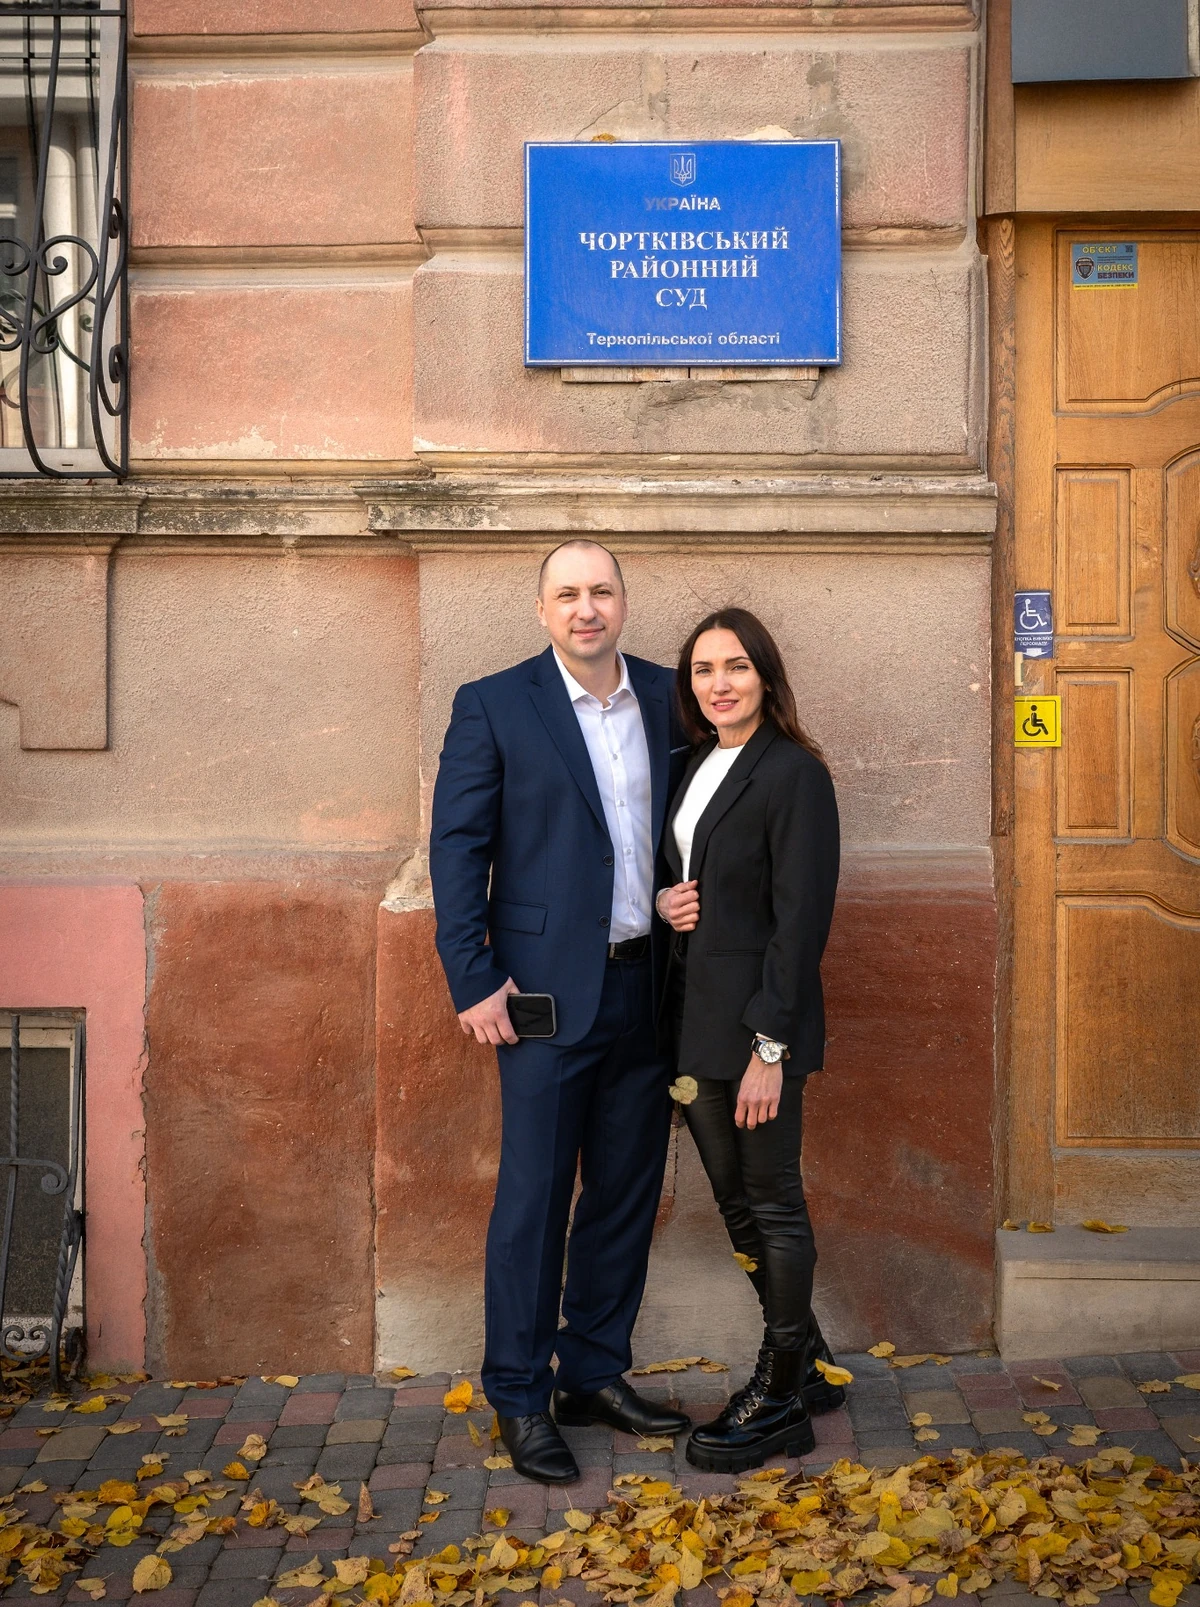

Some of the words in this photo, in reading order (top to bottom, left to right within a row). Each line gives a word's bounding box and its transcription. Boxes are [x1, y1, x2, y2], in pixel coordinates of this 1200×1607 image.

[645, 194, 722, 211] УКРАЇНА
[578, 226, 790, 251] ЧОРТКІВСЬКИЙ
[609, 255, 760, 279] РАЙОННИЙ
[1097, 264, 1133, 272] КОДЕКС
[655, 288, 708, 311] СУД
[586, 331, 713, 348] Тернопільської
[718, 331, 781, 346] області
